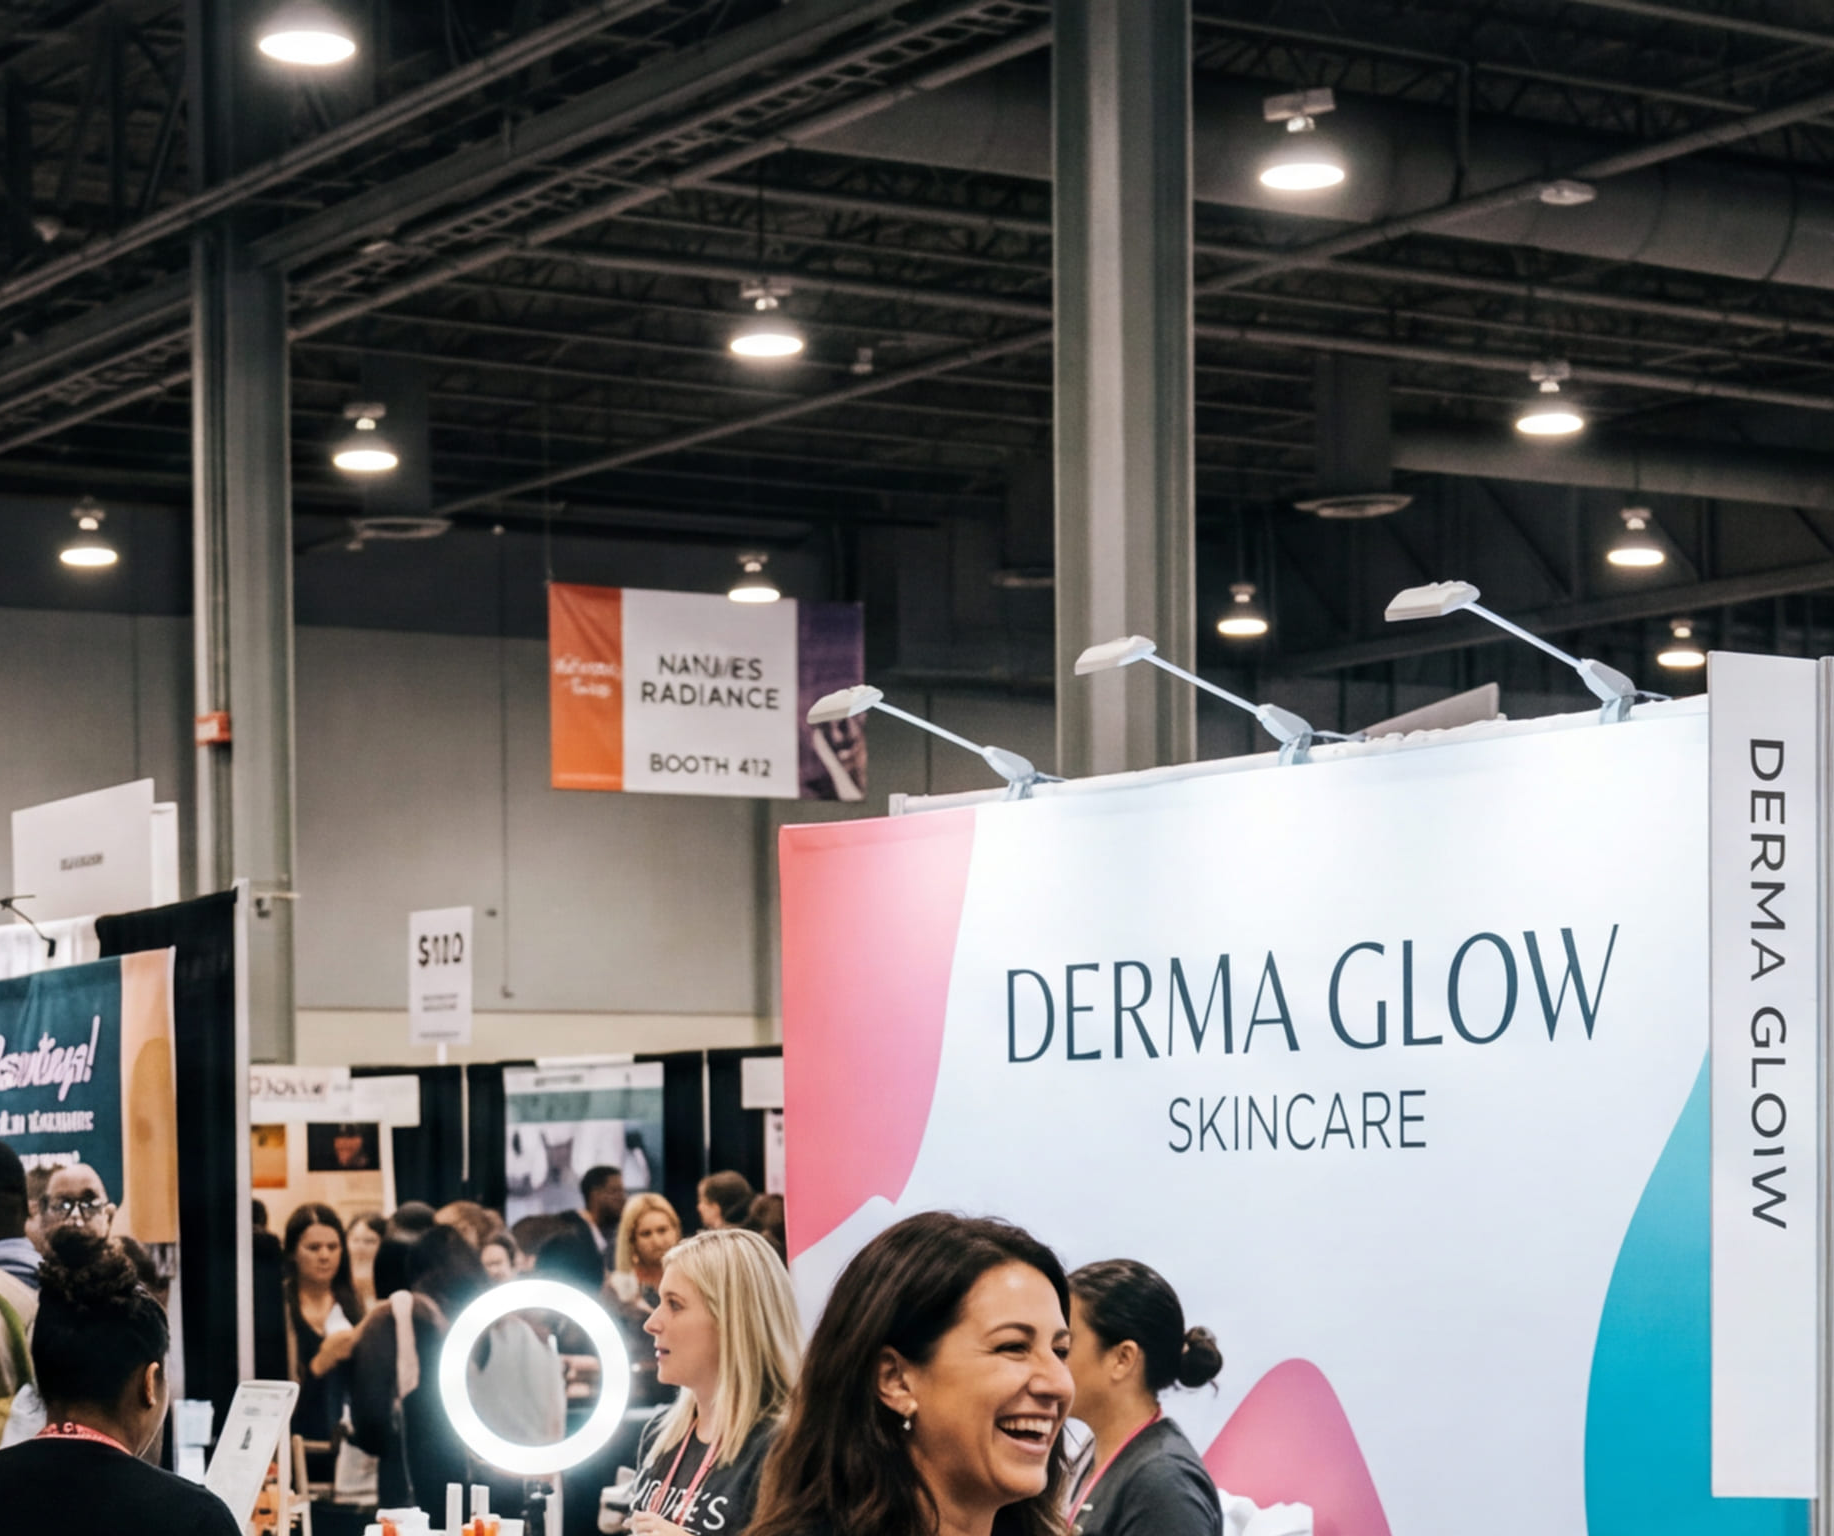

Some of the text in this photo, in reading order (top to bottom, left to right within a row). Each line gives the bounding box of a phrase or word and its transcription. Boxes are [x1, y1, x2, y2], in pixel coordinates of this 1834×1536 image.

[640, 681, 780, 710] RADIANCE
[649, 752, 772, 778] BOOTH 412
[1749, 738, 1787, 982] DERMA
[1006, 923, 1619, 1063] DERMA GLOW
[1168, 1089, 1428, 1154] SKINCARE
